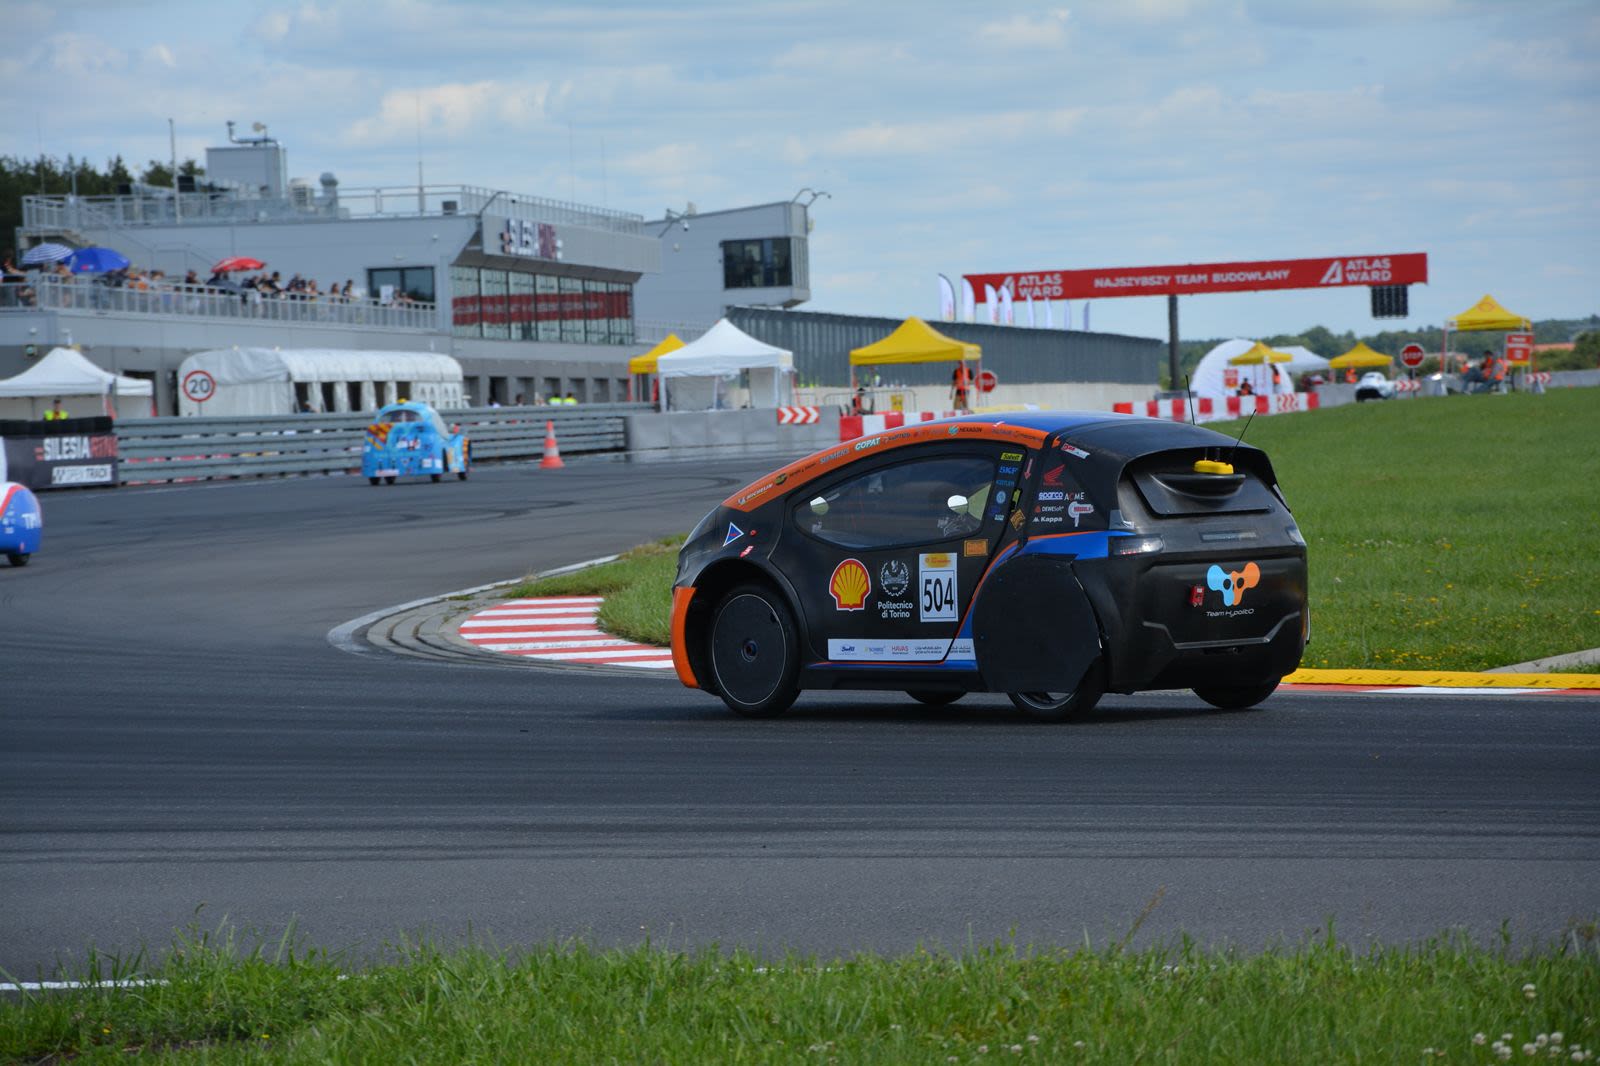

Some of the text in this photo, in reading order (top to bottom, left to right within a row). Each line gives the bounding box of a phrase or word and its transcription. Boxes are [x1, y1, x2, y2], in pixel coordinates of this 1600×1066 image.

[1346, 258, 1391, 270] ATLAS
[1018, 273, 1063, 286] ATLAS
[1094, 269, 1291, 288] NAJSZYBSZY TEAM BUDOWLANY
[1346, 270, 1392, 282] WARD
[1018, 285, 1063, 298] WARD
[190, 378, 210, 394] 20
[1064, 492, 1085, 500] ACME
[924, 577, 954, 613] 504
[877, 601, 914, 610] Politecnico
[881, 609, 911, 619] di Torino
